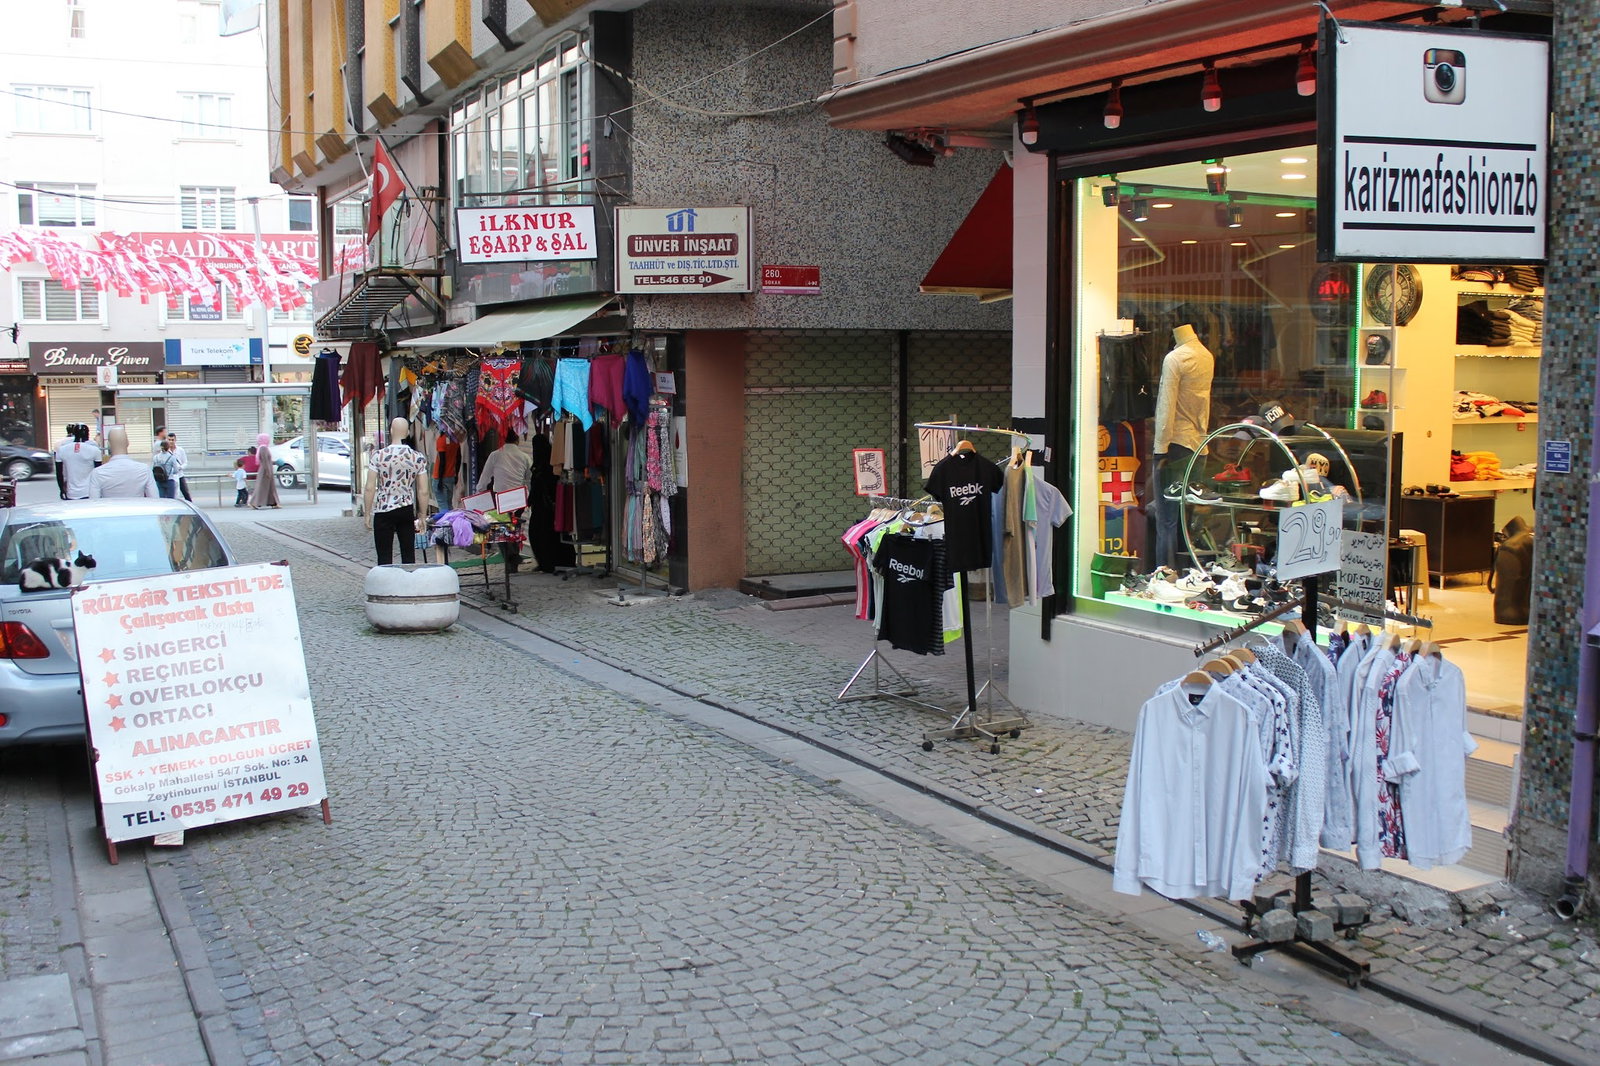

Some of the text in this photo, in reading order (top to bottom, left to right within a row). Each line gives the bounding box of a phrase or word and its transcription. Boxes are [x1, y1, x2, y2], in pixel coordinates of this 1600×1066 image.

[1344, 150, 1538, 216] karizmafashionzb
[469, 232, 587, 257] EŞARP & ŞAL
[634, 236, 732, 254] ÜNVER İNŞAAT
[629, 258, 665, 270] TAAHHÜT
[667, 261, 675, 269] ve
[682, 276, 696, 284] 65
[698, 275, 712, 283] 90
[44, 347, 149, 367] Bahadır Güven
[1265, 405, 1285, 424] ICON
[82, 588, 169, 616] RÜZGÂR
[120, 605, 207, 634] Çalışacak
[213, 600, 255, 617] Usta
[123, 630, 227, 661] SİNGERCİ
[126, 653, 225, 683] REÇMECİ
[129, 672, 263, 706] OVERLOKÇU
[132, 703, 214, 728] ORTACI
[132, 718, 282, 757] ALINACAKTIR
[105, 770, 133, 783] SSK
[209, 747, 264, 765] DOLGUN
[269, 740, 312, 755] ÜCRET
[114, 754, 308, 795] Gökalp Mahallesi 54/7 Sok. No: 3A
[223, 771, 281, 788] İSTANBUL
[123, 782, 309, 827] TEL: 0535 471 49 29
